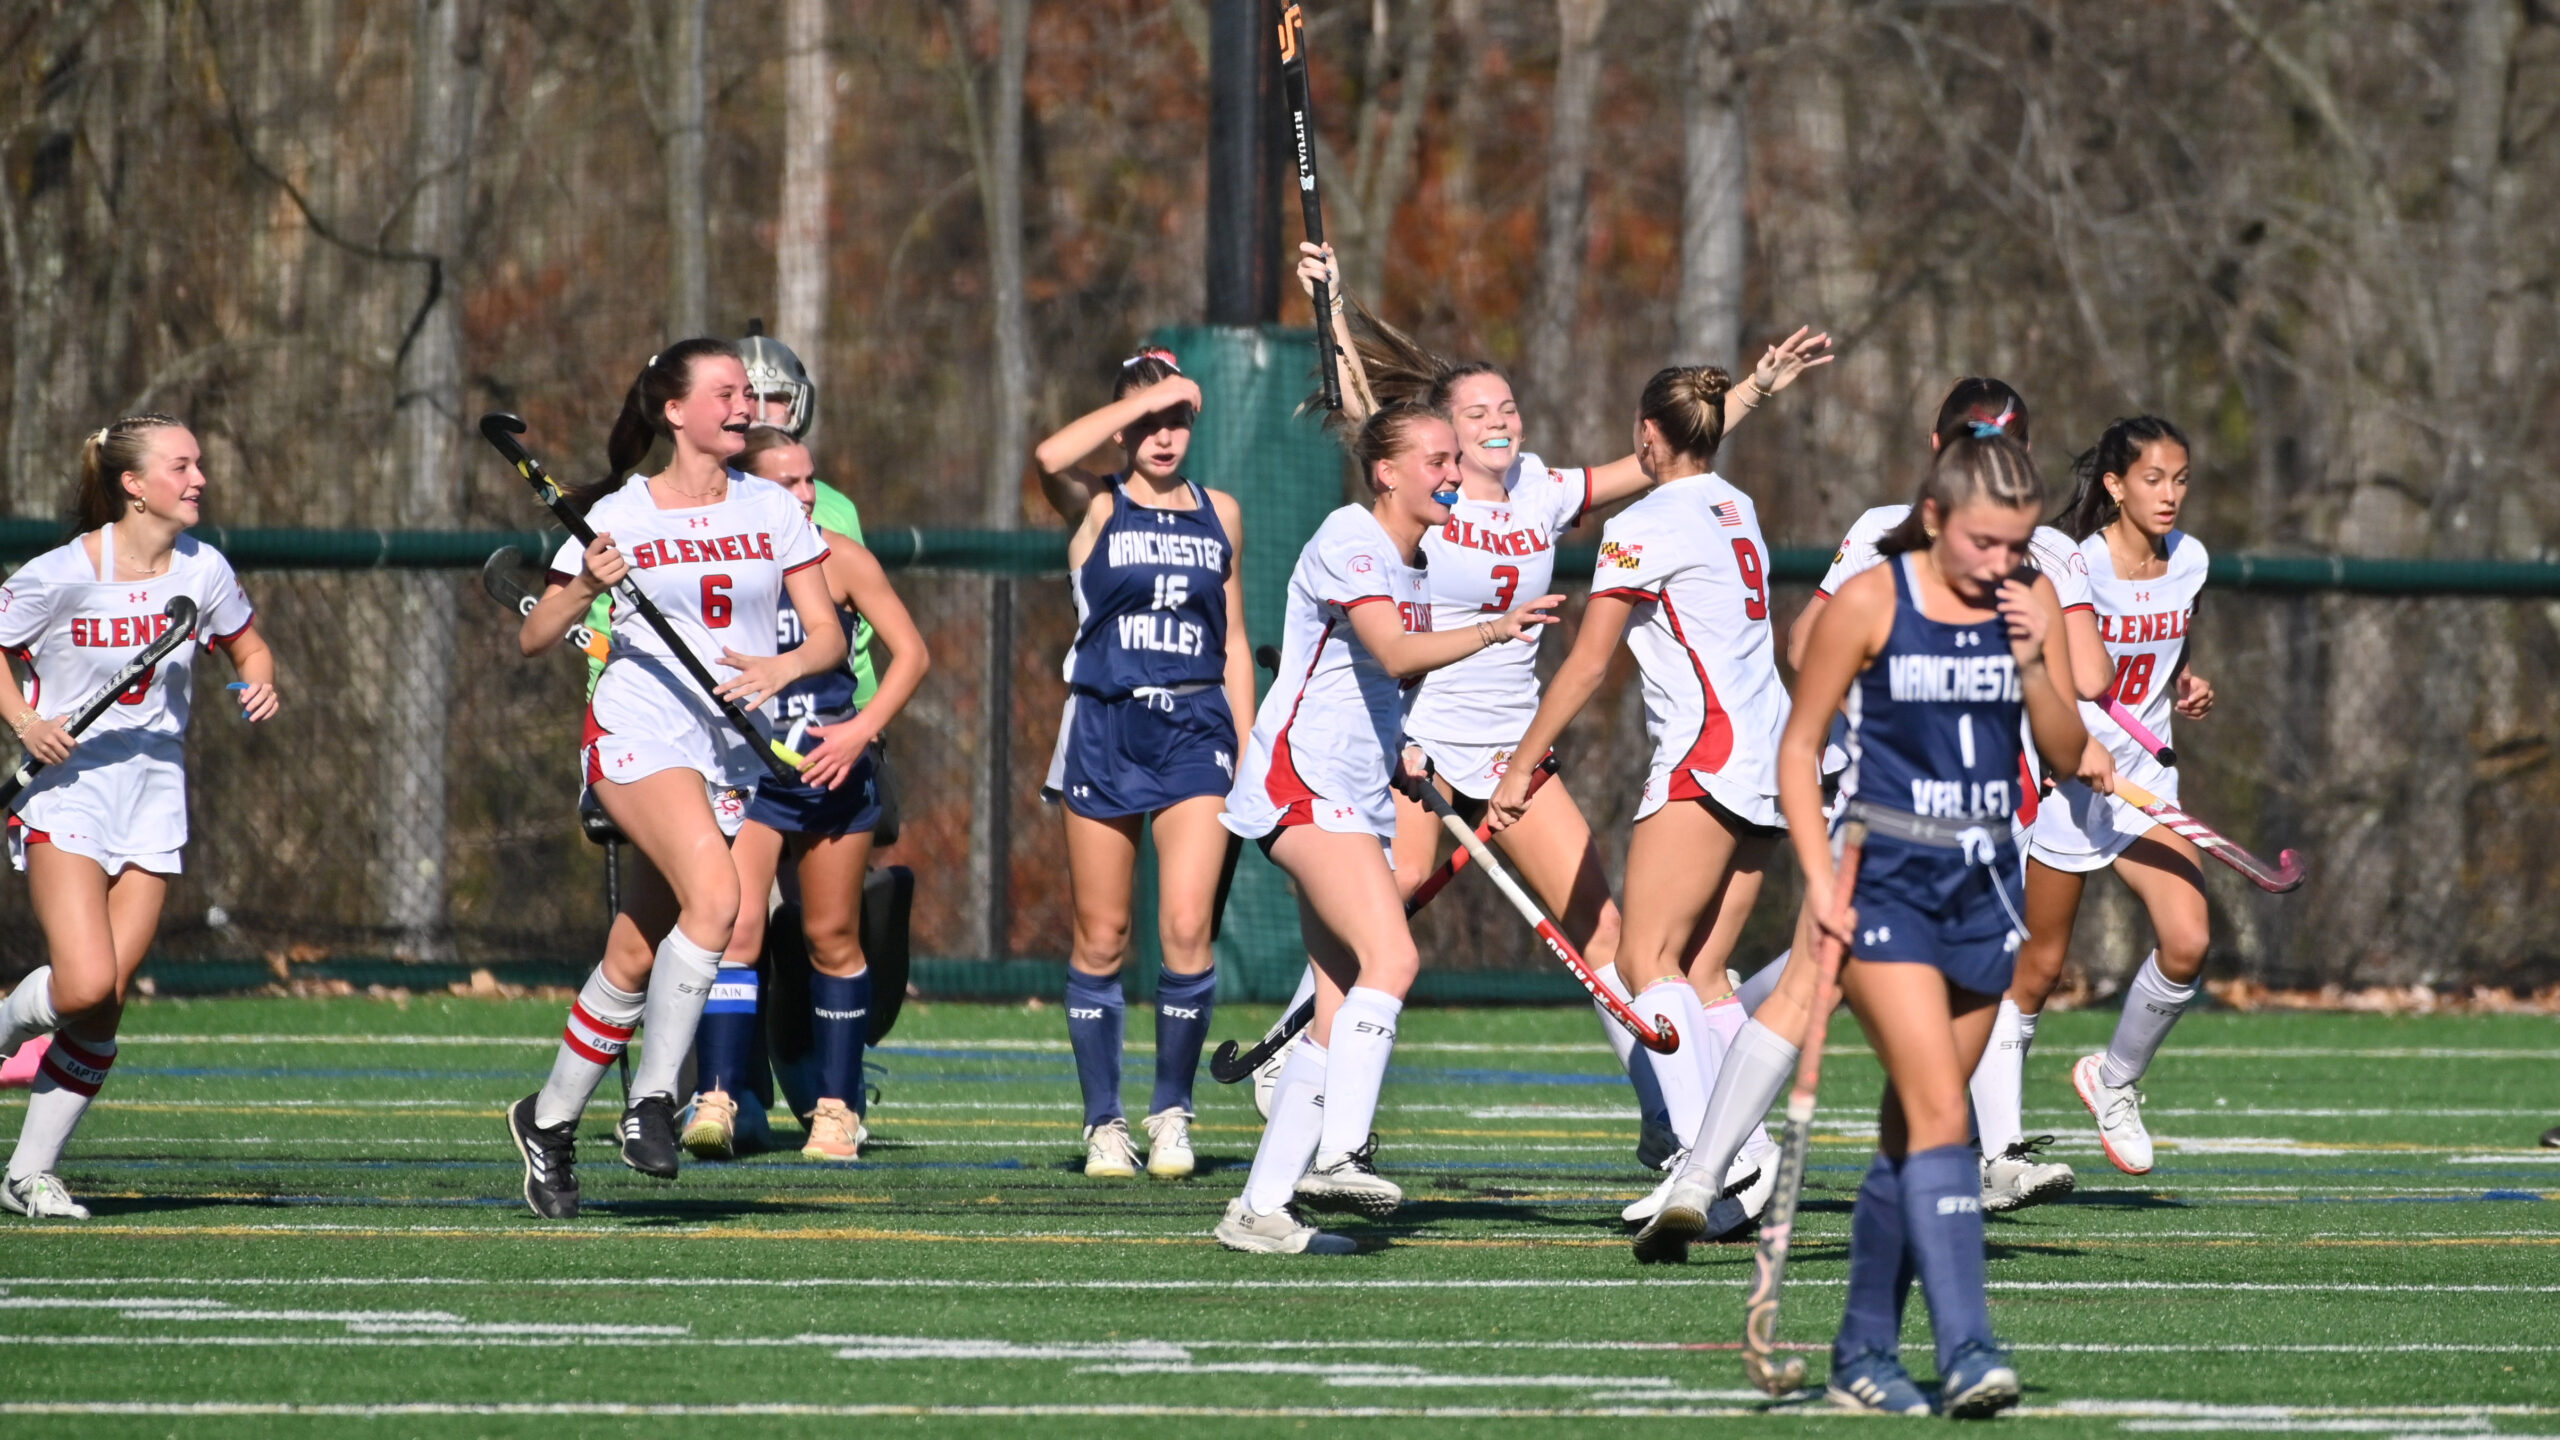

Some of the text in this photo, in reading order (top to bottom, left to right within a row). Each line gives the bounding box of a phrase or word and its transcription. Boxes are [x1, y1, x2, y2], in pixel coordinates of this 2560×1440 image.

[1293, 109, 1309, 176] RITUAL
[632, 532, 775, 570] GLENELG
[1108, 530, 1223, 573] MANCHESTER
[1441, 513, 1551, 557] GLENEL
[1481, 565, 1520, 614] 3
[1731, 537, 1767, 621] 9
[700, 574, 733, 629] 6
[1118, 614, 1203, 657] VALLEY
[1888, 655, 2023, 703] MANCHEST
[2107, 653, 2156, 706] 18
[1957, 713, 1976, 769] 1
[713, 986, 742, 998] TAIN
[815, 1006, 867, 1020] GRYPHON
[1069, 1007, 1103, 1019] STX
[1162, 1004, 1200, 1019] STX
